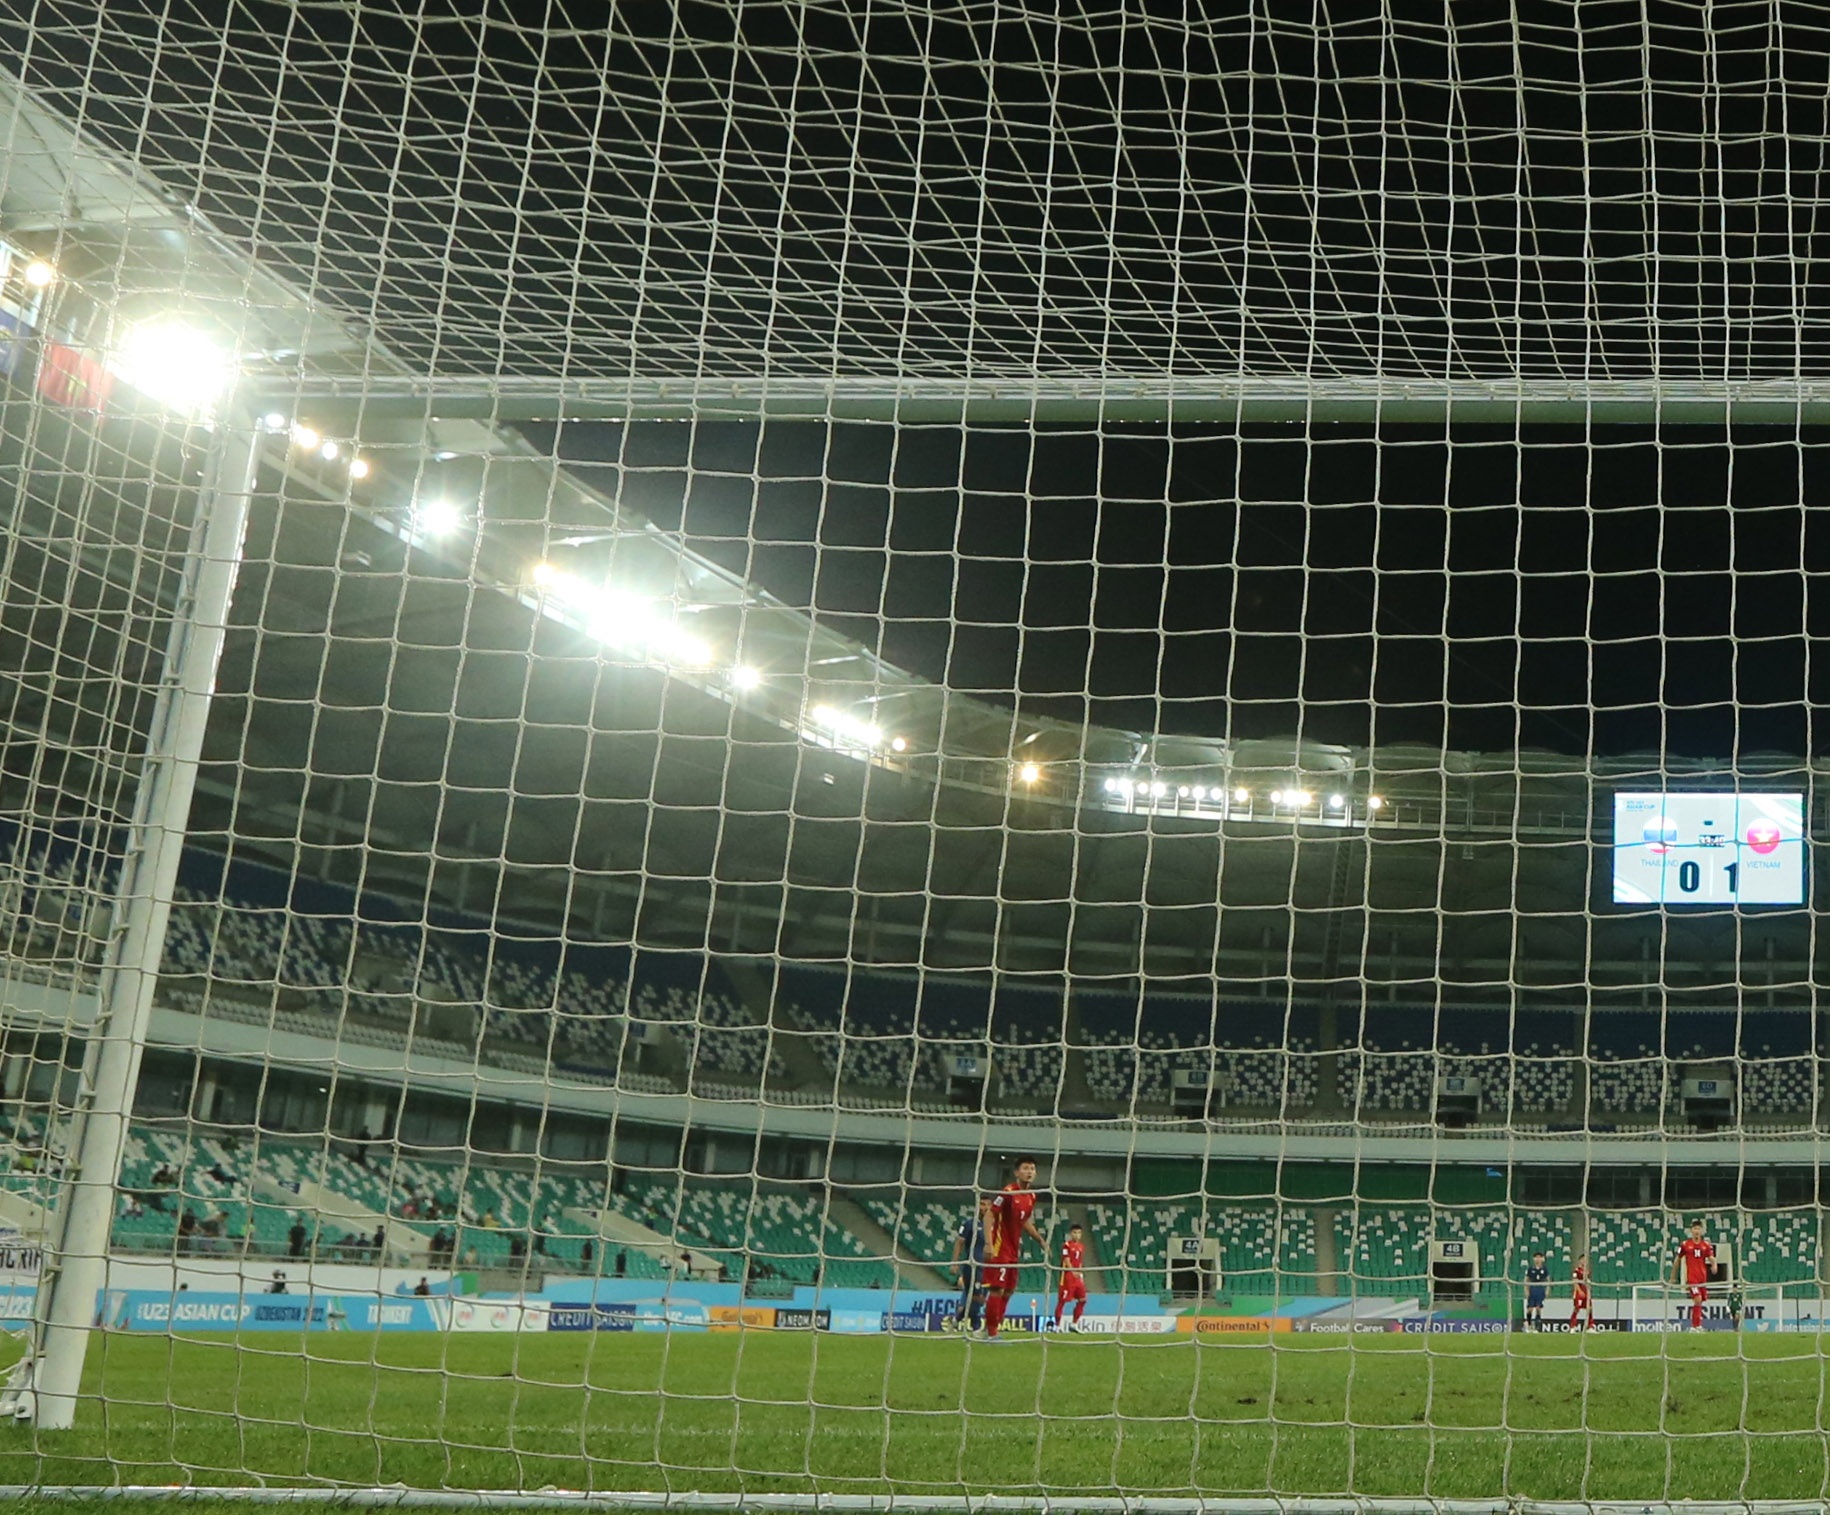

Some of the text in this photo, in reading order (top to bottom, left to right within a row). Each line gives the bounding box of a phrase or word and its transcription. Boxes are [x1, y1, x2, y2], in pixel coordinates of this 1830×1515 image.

[1680, 861, 1699, 893] 0
[1723, 862, 1738, 893] 1
[1446, 1244, 1460, 1253] 4B
[998, 1267, 1007, 1282] 2
[174, 1303, 218, 1321] ASIAN
[220, 1304, 253, 1321] CUP
[1197, 1320, 1260, 1332] Continental
[1354, 1323, 1385, 1333] Cares
[1633, 1321, 1681, 1332] molten
